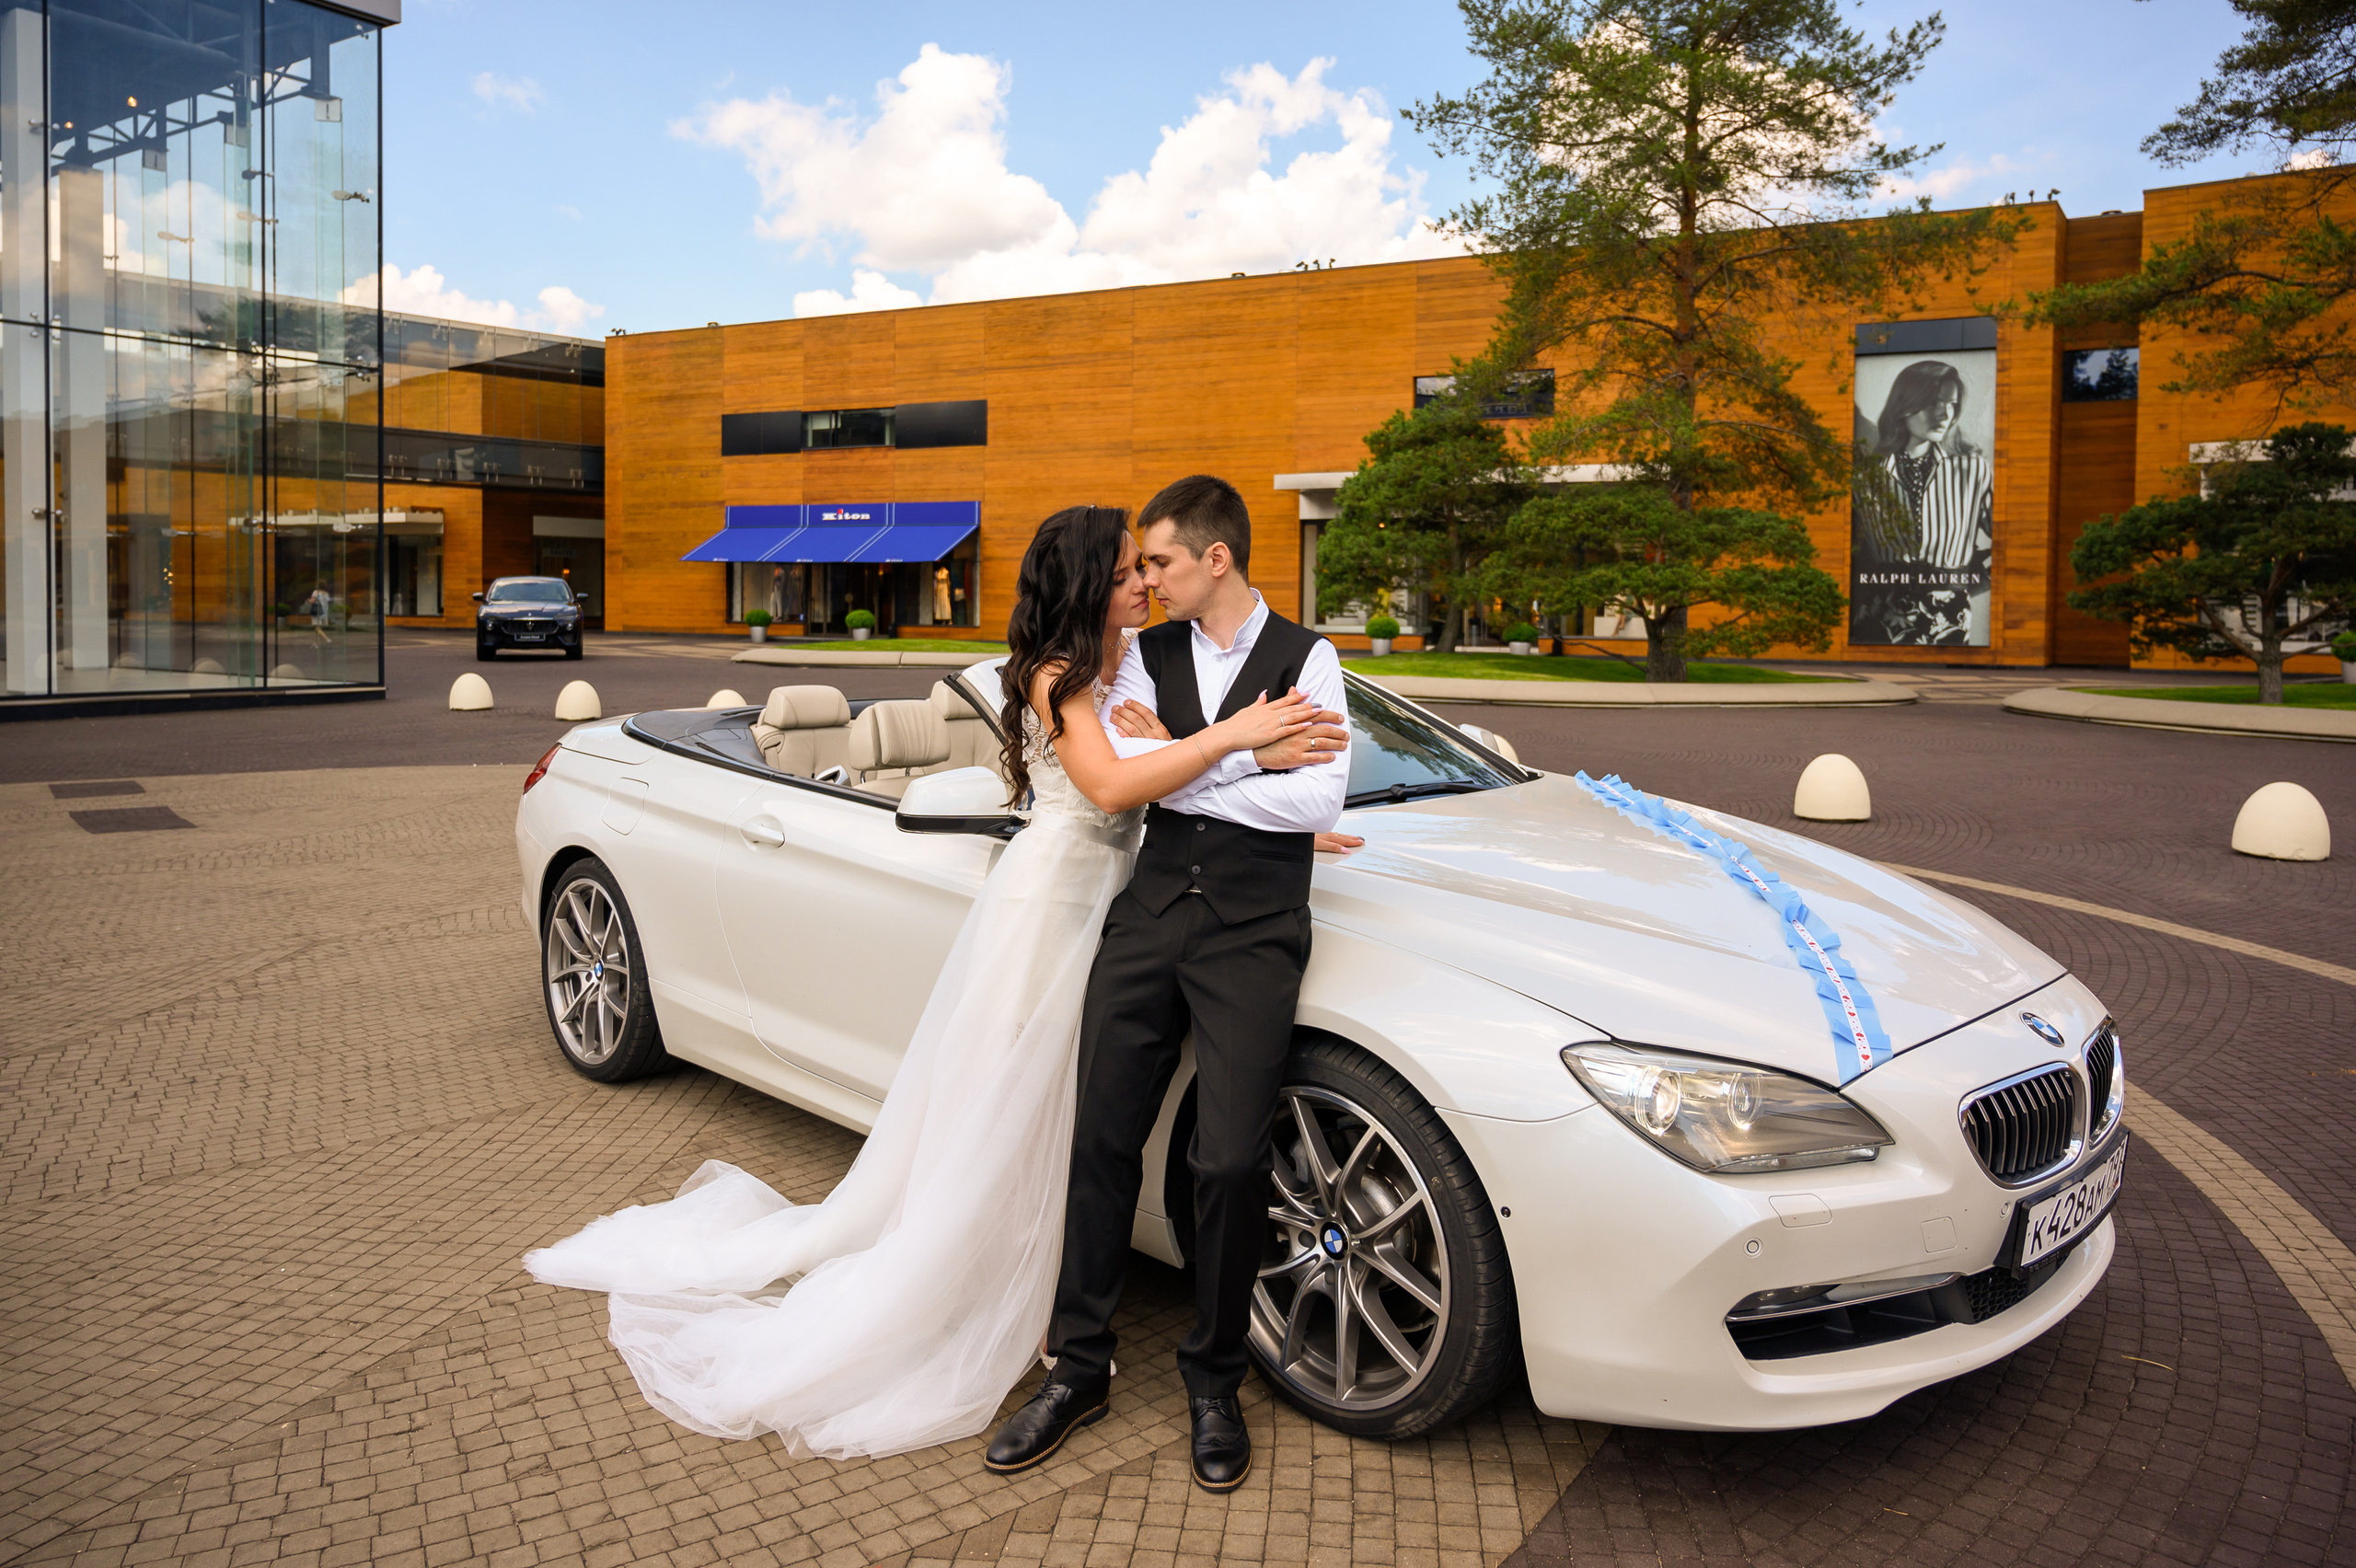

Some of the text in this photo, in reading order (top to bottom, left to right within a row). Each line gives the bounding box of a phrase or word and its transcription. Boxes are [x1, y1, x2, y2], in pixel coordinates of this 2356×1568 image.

[822, 508, 871, 521] Kiton
[1859, 572, 1981, 584] RALPH LAUREN
